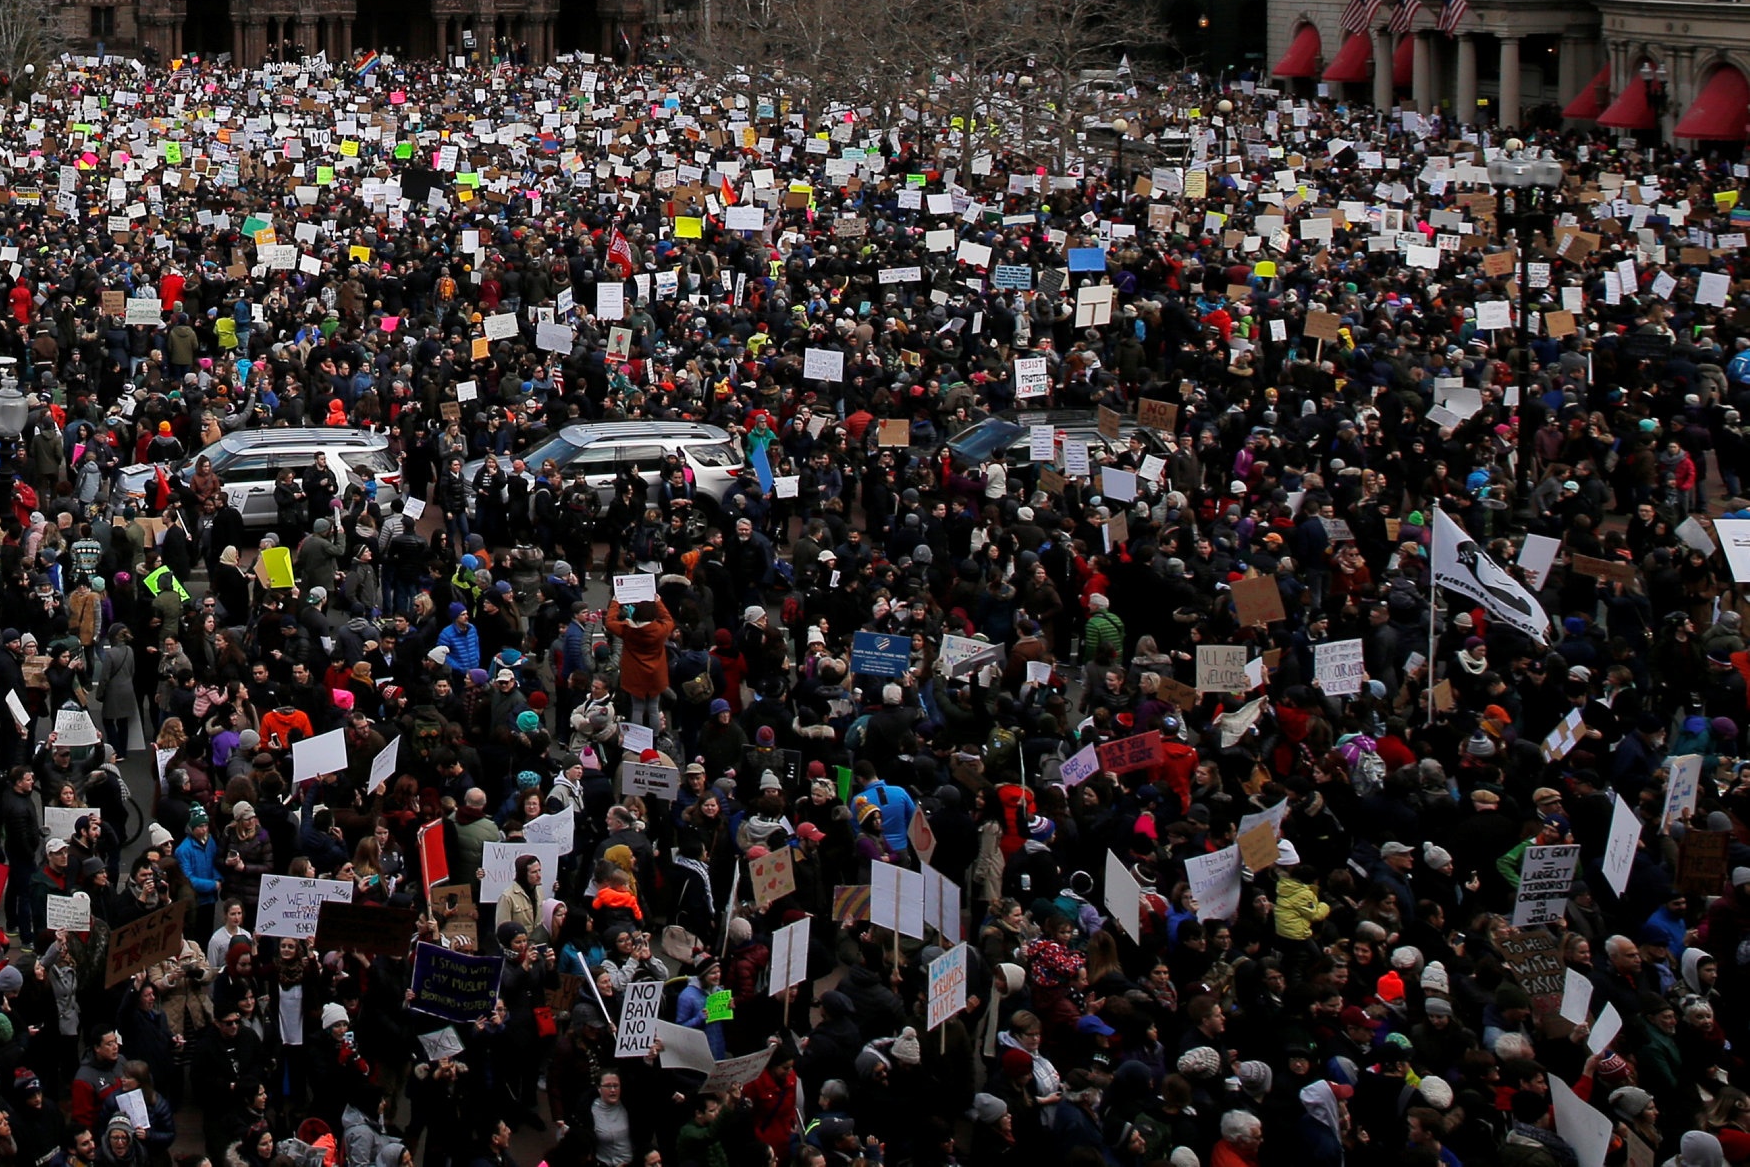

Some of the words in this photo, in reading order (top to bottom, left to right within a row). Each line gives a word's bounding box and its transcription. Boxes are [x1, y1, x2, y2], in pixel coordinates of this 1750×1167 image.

[312, 131, 330, 144] NO
[1021, 360, 1043, 371] RESIST
[1021, 374, 1046, 384] PROTECT
[1147, 403, 1167, 416] NO
[1201, 650, 1218, 666] ALL
[1225, 652, 1244, 666] ARE
[1199, 669, 1245, 684] WELCOME
[58, 712, 85, 722] BOSTON
[1063, 757, 1080, 776] NEVER
[1529, 848, 1545, 860] US
[1523, 868, 1570, 881] LARGEST
[299, 879, 315, 889] SYRIA
[1522, 880, 1570, 890] TERRORIST
[285, 893, 303, 906] WE
[1527, 914, 1558, 924] WORLD
[294, 923, 314, 933] YEMEN
[1502, 940, 1523, 954] TO
[1524, 935, 1554, 950] HELL
[431, 956, 435, 967] I
[439, 958, 468, 975] STAND
[932, 948, 960, 979] LOVE
[1511, 954, 1559, 972] WITH
[432, 972, 448, 983] MY
[452, 978, 488, 993] MUSLIM
[933, 965, 965, 996] TRUMPS
[630, 984, 655, 1001] NO
[626, 1000, 658, 1020] BAN
[933, 990, 957, 1023] HATE
[626, 1020, 646, 1034] NO
[620, 1036, 652, 1051] WALL
